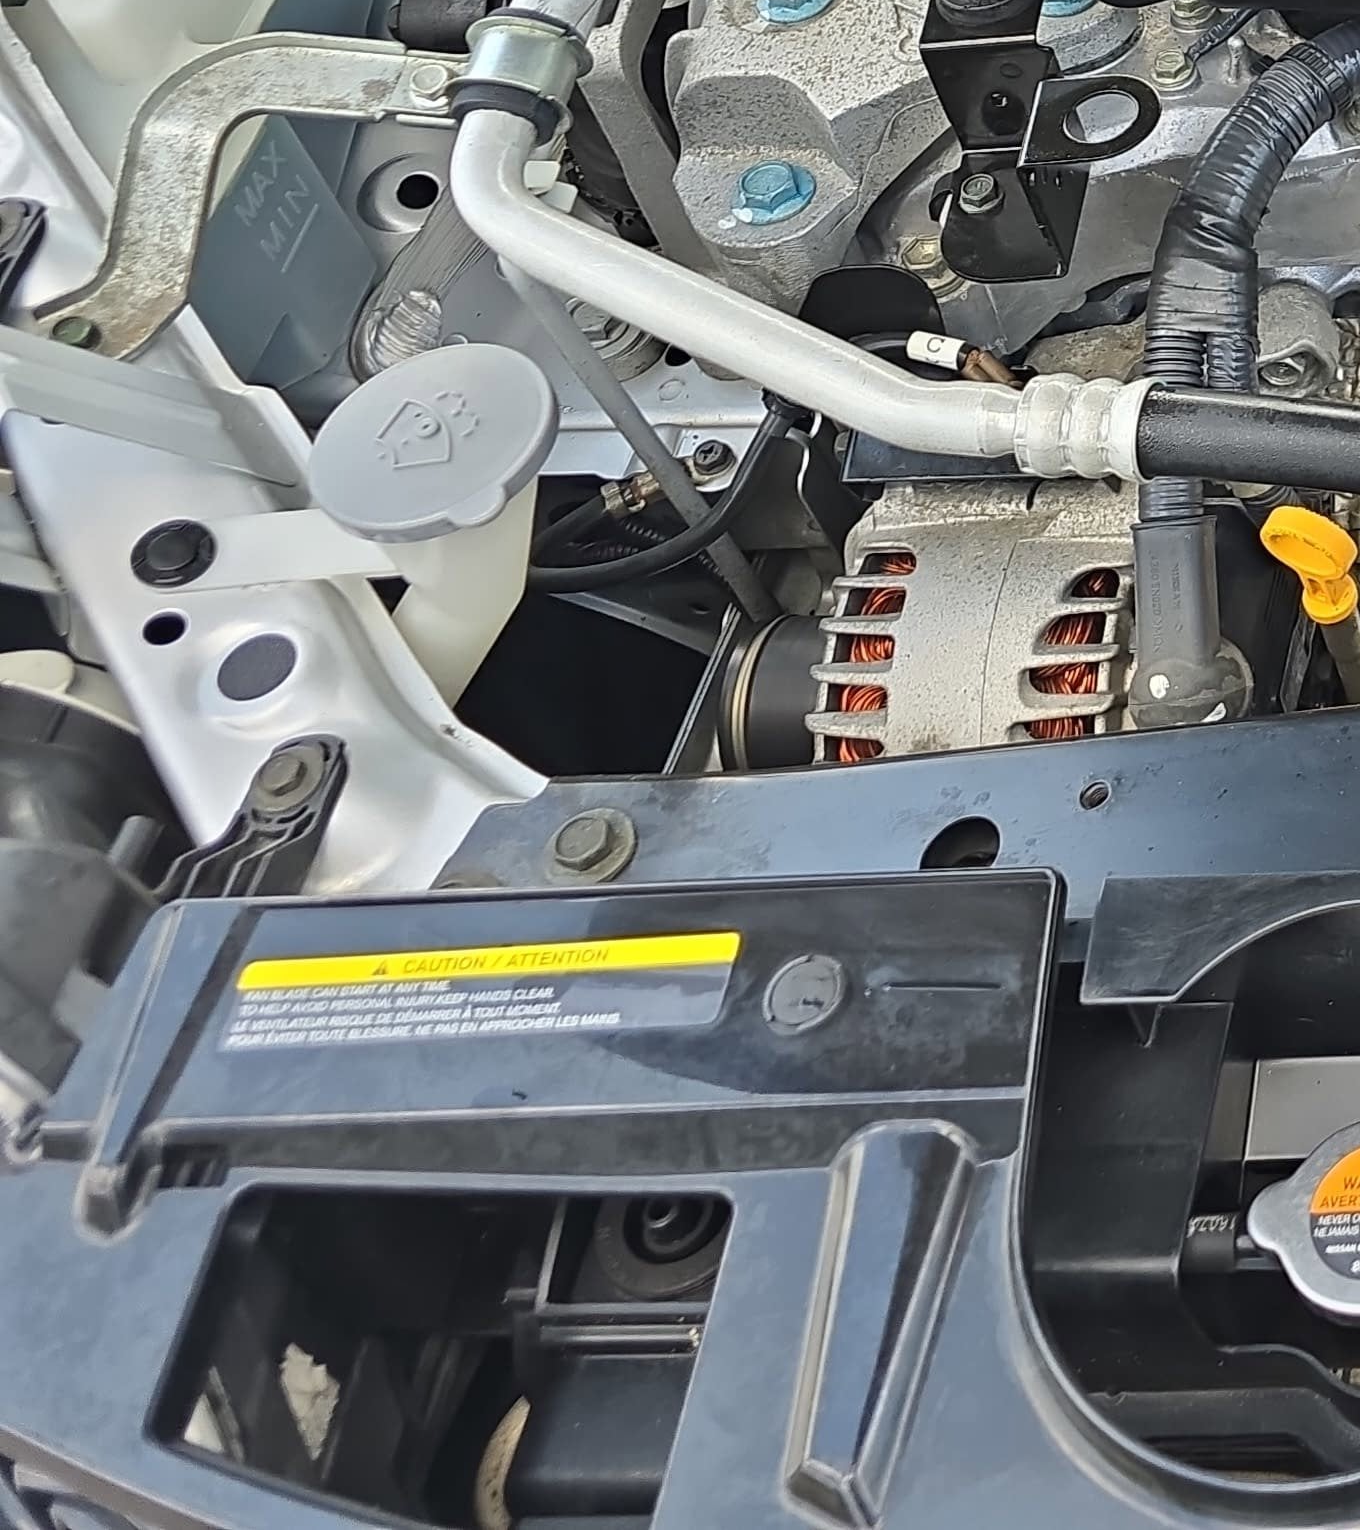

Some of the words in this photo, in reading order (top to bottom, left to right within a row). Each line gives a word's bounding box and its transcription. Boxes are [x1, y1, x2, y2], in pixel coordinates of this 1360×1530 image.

[234, 138, 289, 228] MAX
[260, 173, 312, 263] MIN
[926, 336, 946, 353] C
[402, 954, 488, 975] CAUTION
[505, 948, 610, 969] ATTENTION
[258, 1001, 292, 1015] HELP
[291, 1000, 330, 1013] AVOID
[329, 997, 394, 1012] PERSONAL
[468, 989, 513, 1003] HANDS
[270, 987, 311, 1000] BLADE
[311, 986, 339, 998] CAN
[340, 984, 380, 997] START
[380, 983, 396, 995] AT
[395, 982, 421, 994] ANY
[249, 1016, 329, 1032] VENTILATEUR
[328, 1013, 380, 1027] RISQUE
[379, 1011, 396, 1024] DE
[395, 1007, 465, 1023] DÉMARRER
[473, 1005, 507, 1019] TOUT
[307, 1028, 348, 1043] TOUTE
[434, 1022, 460, 1035] PAS
[459, 1020, 479, 1034] EN
[477, 1016, 555, 1032] APPROCHER
[554, 1014, 581, 1029] LES
[1317, 1213, 1351, 1226] NEVER
[1326, 1225, 1360, 1237] JAMAIS
[1324, 1242, 1357, 1254] NISSAN
